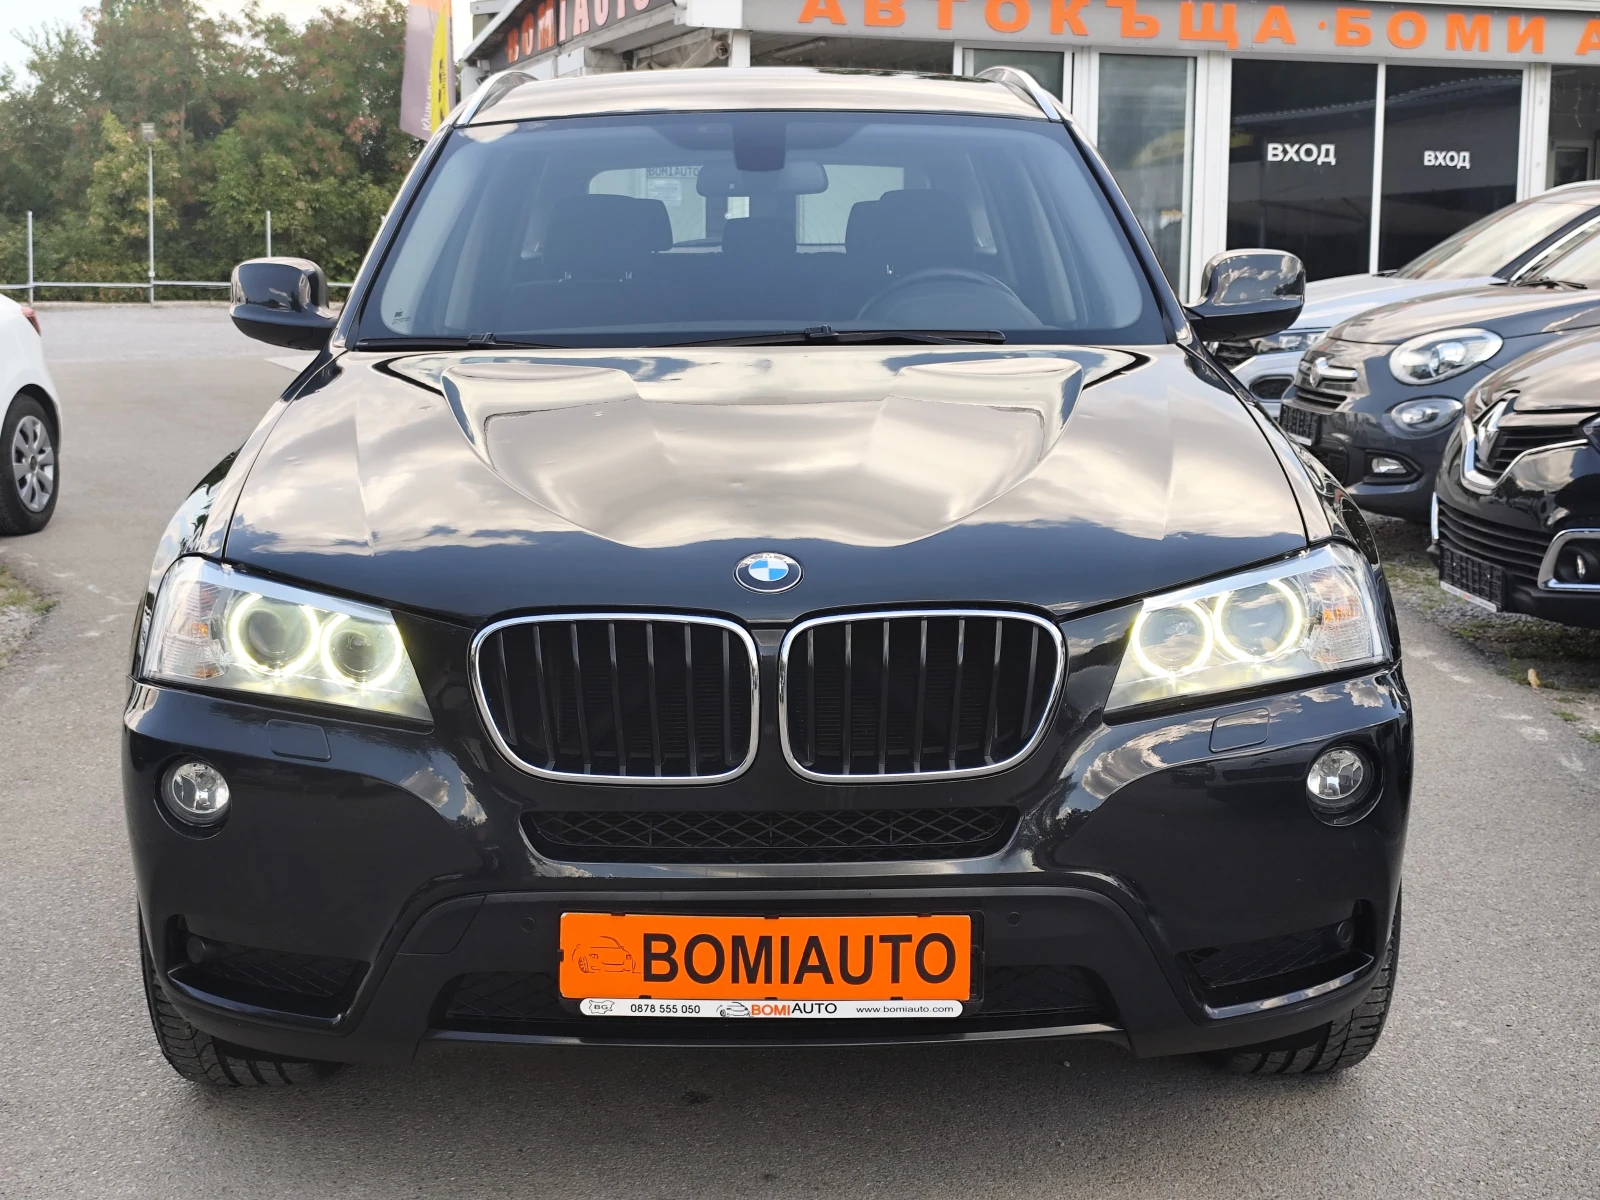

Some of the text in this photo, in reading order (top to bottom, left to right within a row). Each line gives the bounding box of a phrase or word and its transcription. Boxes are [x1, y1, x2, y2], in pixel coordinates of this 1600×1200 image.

[506, 0, 650, 64] BOMIA
[1266, 143, 1337, 166] ВХОД
[1423, 150, 1471, 170] ВХОД
[642, 932, 957, 985] BOMIAUTO
[630, 1003, 701, 1014] 0878 555 050
[856, 1005, 954, 1013] www.bomiauto.com
